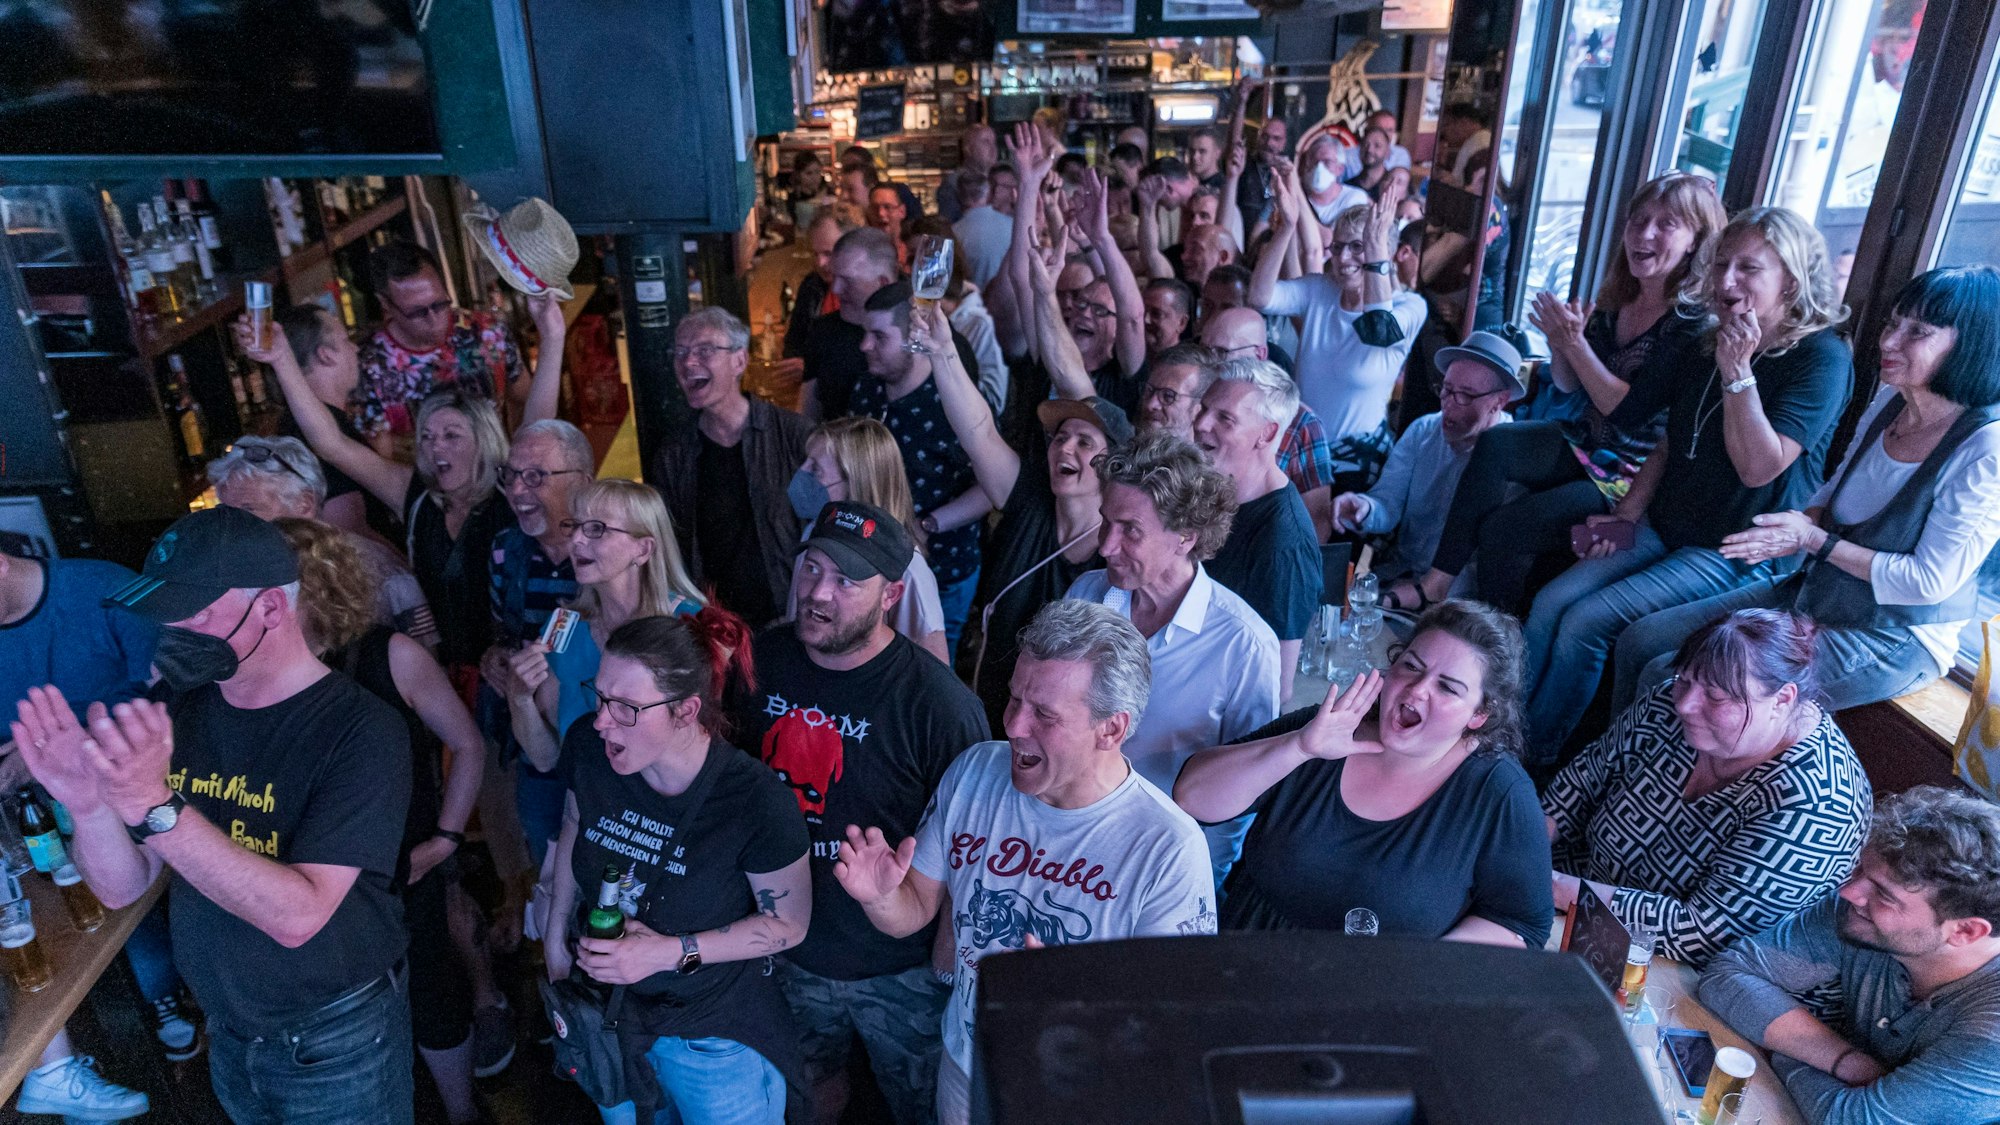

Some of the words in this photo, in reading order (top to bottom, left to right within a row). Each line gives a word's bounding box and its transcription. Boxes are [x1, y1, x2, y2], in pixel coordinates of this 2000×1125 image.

[191, 773, 223, 799] mit
[597, 816, 632, 839] SCHON
[631, 832, 663, 851] IMMER
[621, 809, 640, 826] ICH
[641, 816, 675, 838] WOLLTE
[584, 828, 601, 843] MIT
[600, 836, 650, 862] MENSCHEN
[949, 832, 986, 870] El
[987, 837, 1118, 901] Diablo
